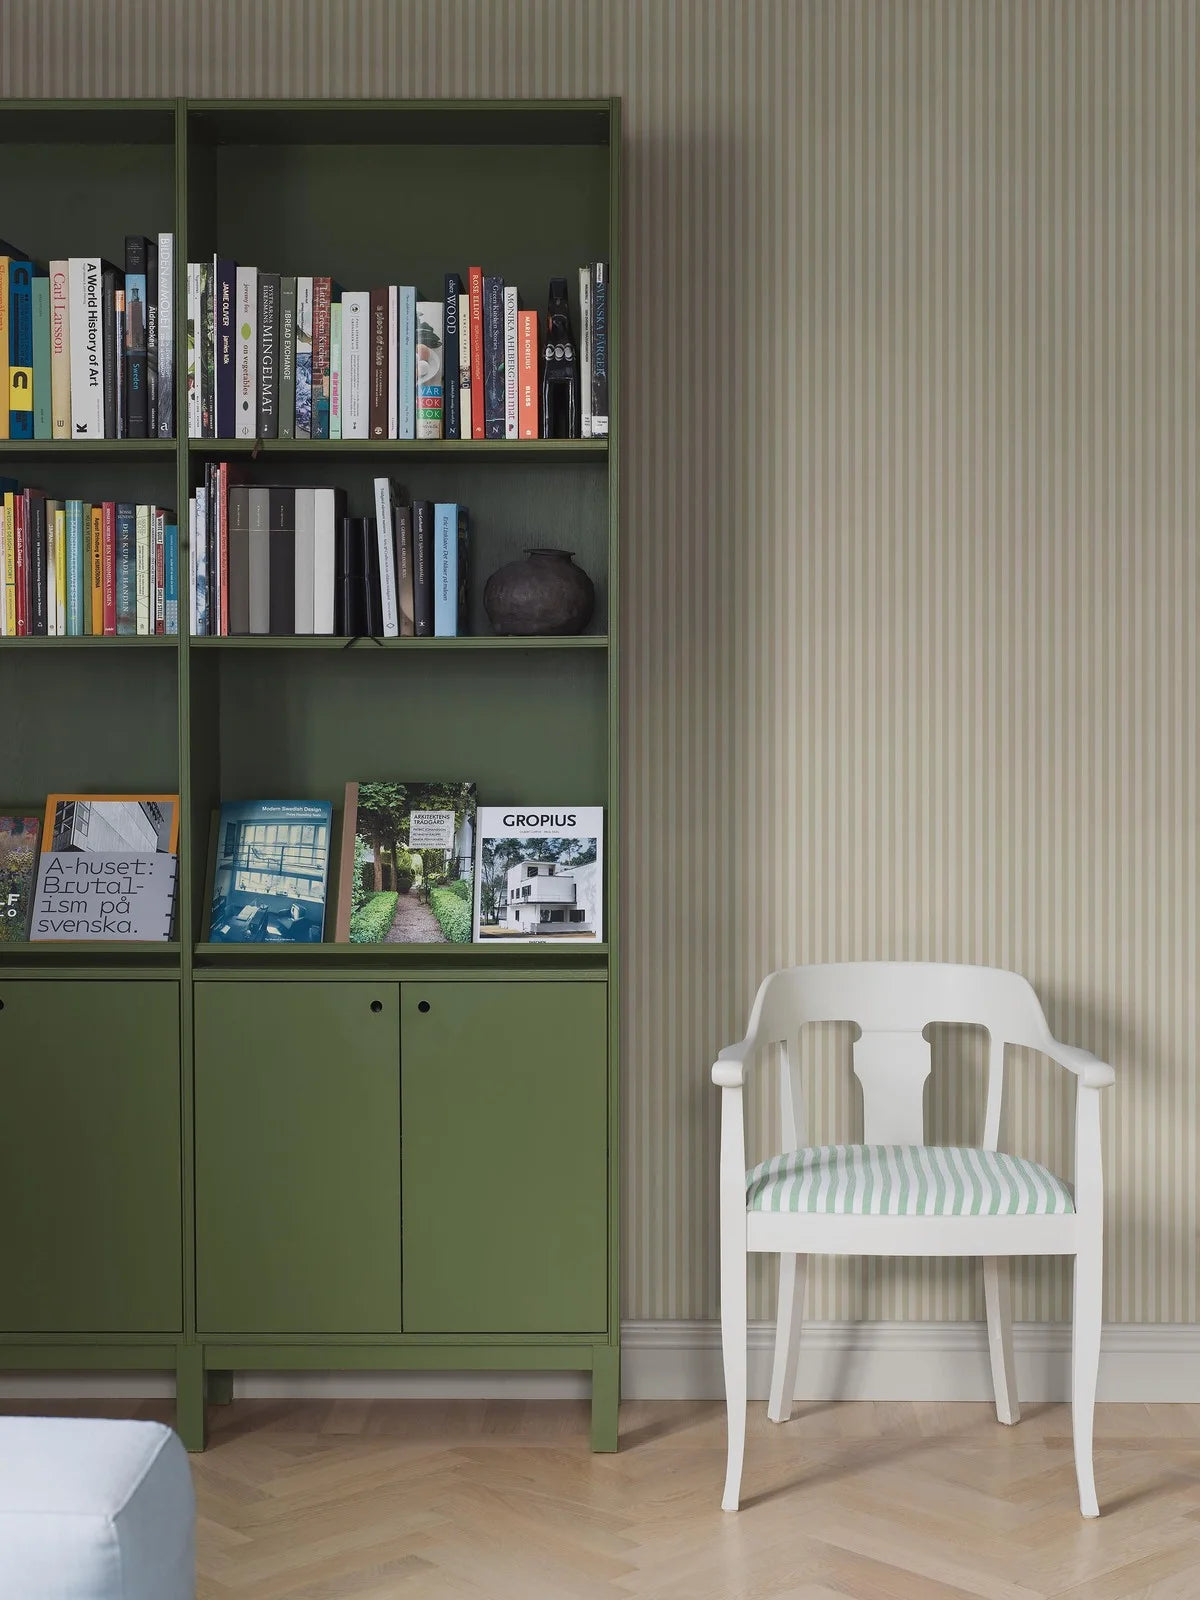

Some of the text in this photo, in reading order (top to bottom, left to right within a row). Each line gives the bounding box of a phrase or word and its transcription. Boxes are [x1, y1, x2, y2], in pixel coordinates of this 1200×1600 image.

[160, 238, 170, 277] BILDEN
[54, 273, 66, 354] Carl Larsson
[222, 282, 230, 327] JAMIE OLIVER
[318, 310, 327, 334] Green
[447, 294, 457, 334] WOOD
[492, 305, 500, 329] Kitchen
[596, 283, 605, 331] SVENSKA
[86, 263, 99, 387] A World History of Art
[148, 306, 158, 347] Äldreboken
[222, 335, 230, 353] jamies
[318, 336, 327, 367] Kitchen
[596, 333, 607, 375] FÄRGER
[132, 363, 140, 390] Sweden
[241, 345, 250, 396] on vegetables
[262, 325, 273, 415] MINGELMAT
[502, 814, 577, 827] GROPIUS
[45, 857, 153, 875] A-huset:
[43, 876, 144, 894] Brutal-
[40, 895, 130, 917] ism på
[37, 915, 138, 933] svenska.
